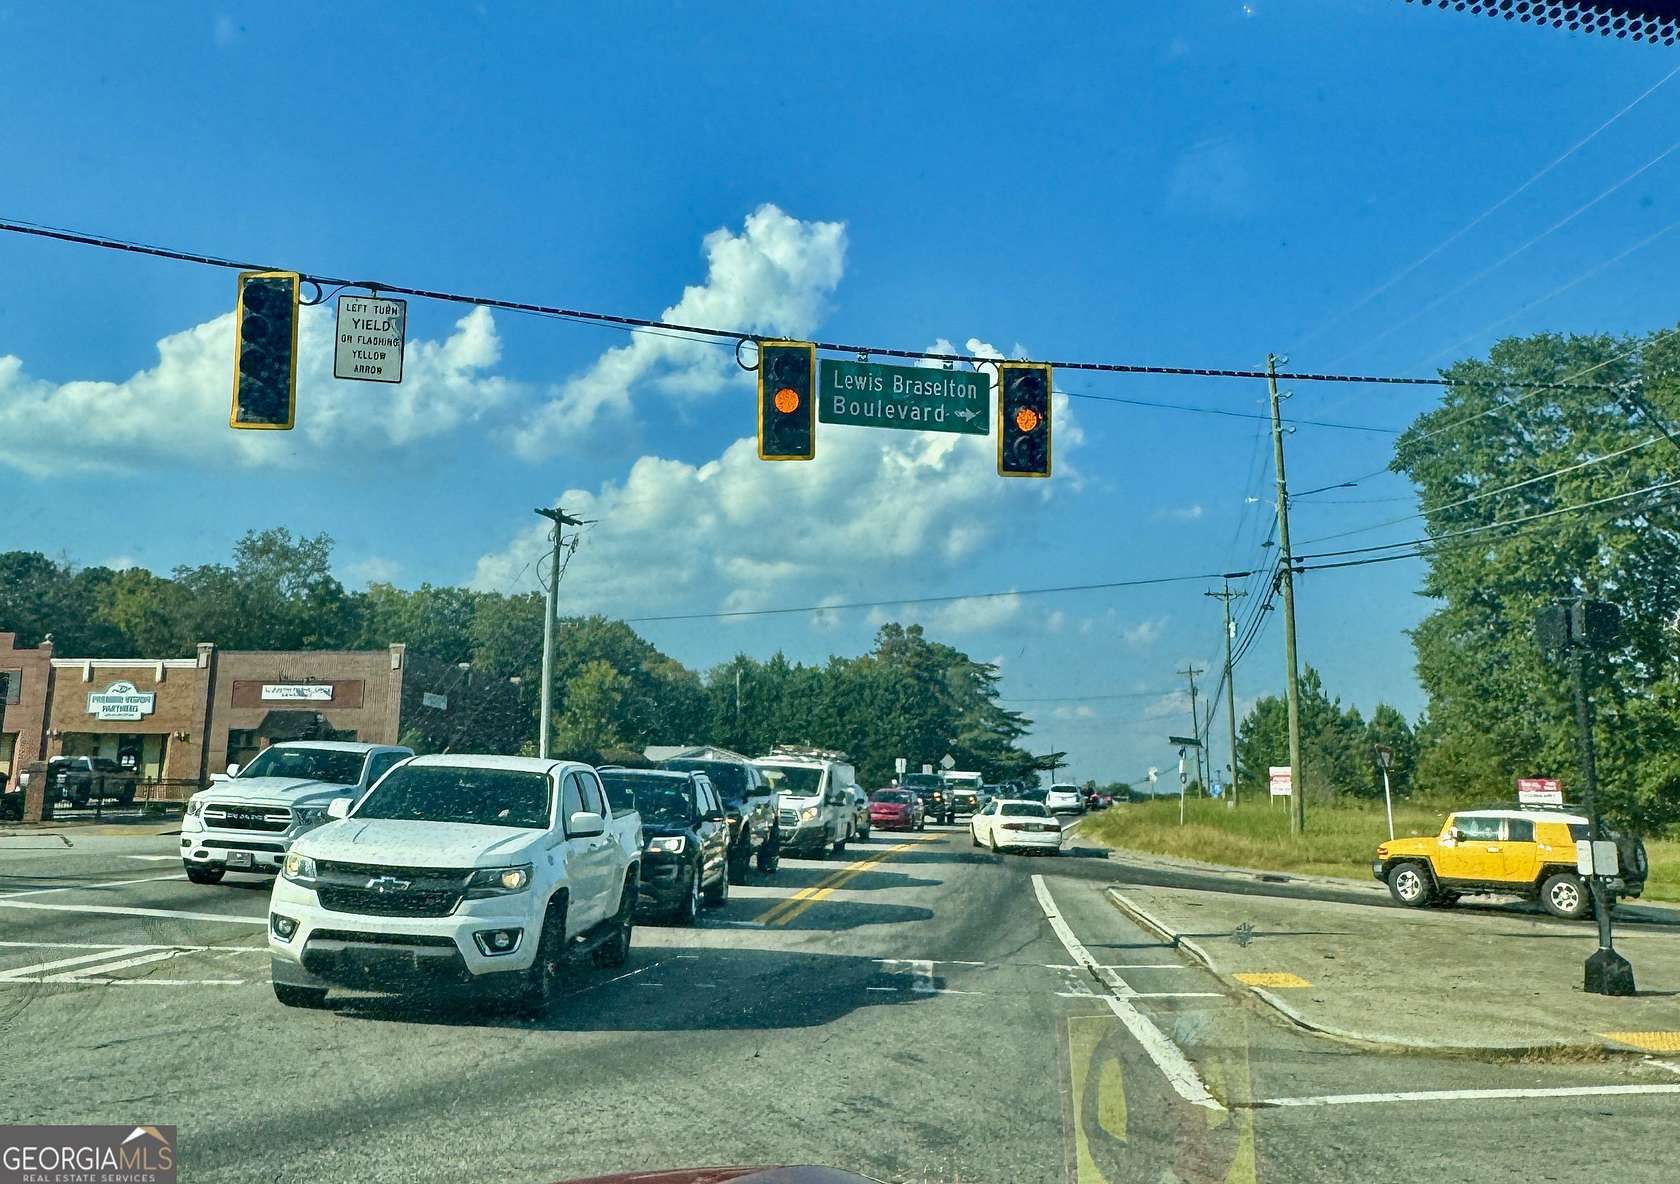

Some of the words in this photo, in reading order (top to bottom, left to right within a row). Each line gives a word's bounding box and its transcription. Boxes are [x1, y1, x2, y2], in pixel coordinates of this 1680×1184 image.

[346, 304, 367, 313] LEFT
[374, 305, 398, 315] TURN
[352, 318, 391, 331] YIELD
[341, 334, 353, 343] OR
[357, 336, 400, 347] FLASHING
[352, 350, 386, 360] YELLOW
[354, 365, 382, 374] ARROW
[834, 370, 883, 391] Lewis
[893, 375, 977, 399] Braselton
[833, 395, 945, 422] Boulevard
